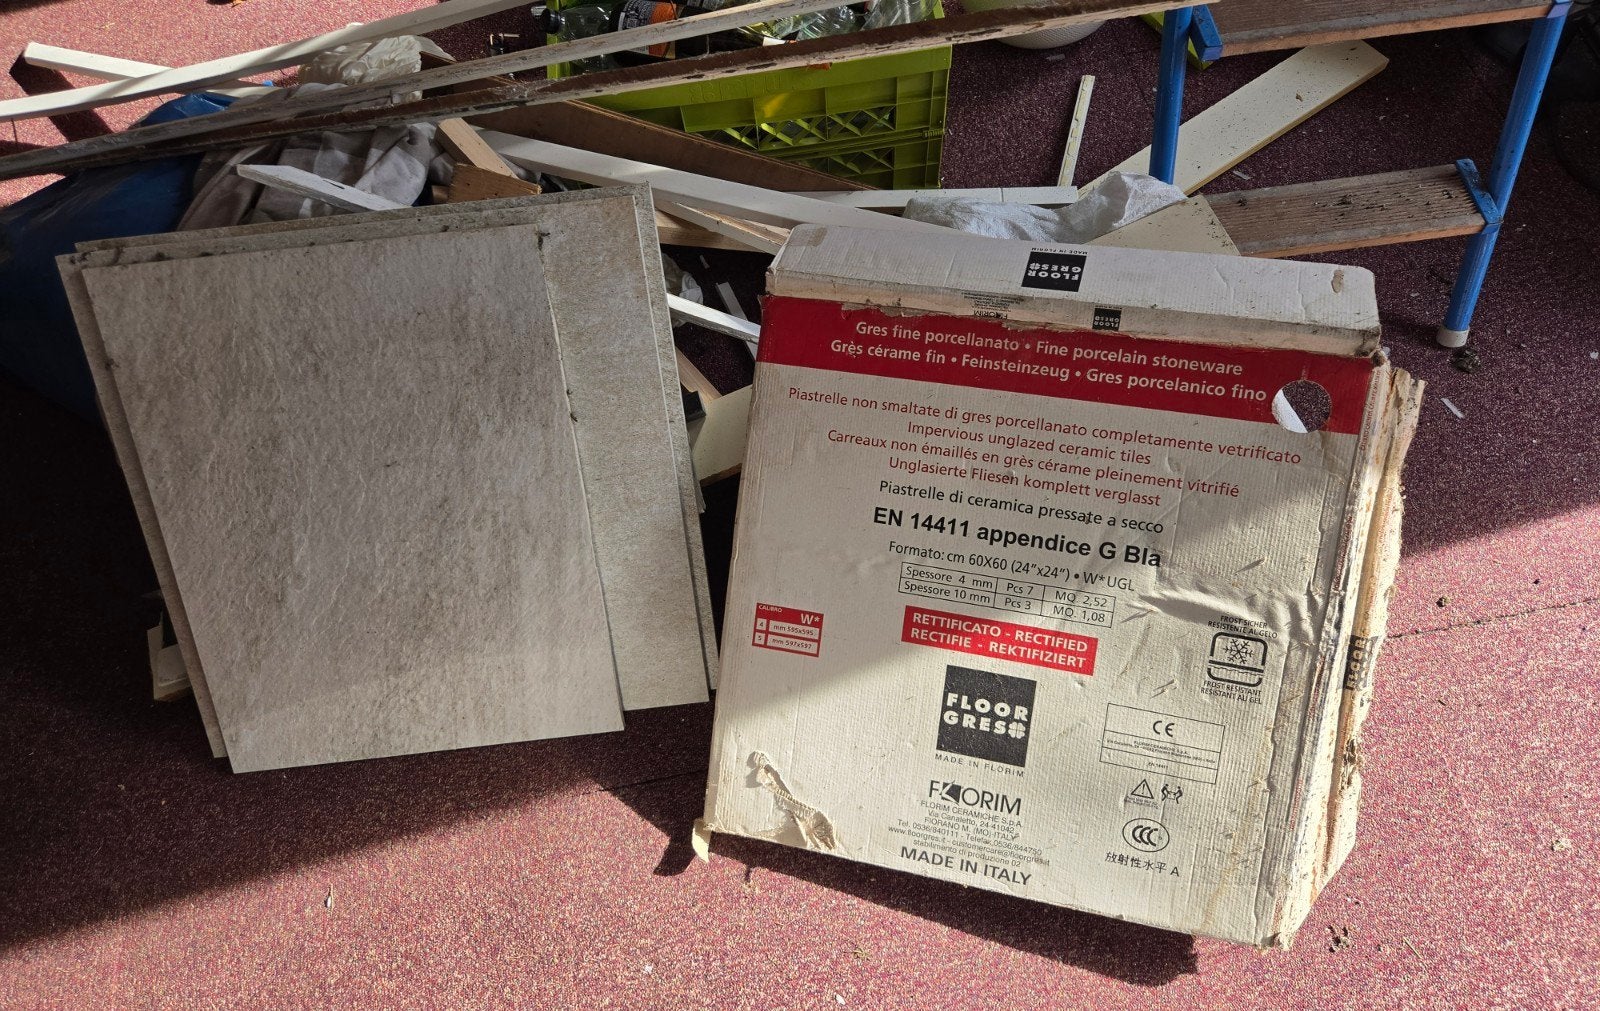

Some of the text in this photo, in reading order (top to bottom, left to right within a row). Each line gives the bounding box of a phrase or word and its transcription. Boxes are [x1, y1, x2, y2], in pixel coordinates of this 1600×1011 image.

[1027, 270, 1079, 281] FLOOR
[1041, 264, 1081, 273] GRES
[856, 321, 1243, 376] Gres fine porcellanato Fine porcelain stoneware
[831, 339, 1267, 401] Grès cérame fin Feinsteinzeug Gres porcelanico fino
[788, 387, 1302, 464] Piastrelle non smaltate di gres porcellanato completamente vetrificato
[908, 421, 1151, 465] Impervious unglazed ceramic tiles
[828, 429, 1240, 498] Carreaux non émaillés en grès cérame pleinement vitrifié
[889, 456, 1161, 507] Unglasierte Fliesen komplett verglasst
[879, 480, 1164, 534] Piastrelle di ceramica pressate a secco
[873, 506, 903, 527] EN
[910, 512, 969, 537] 14411
[976, 526, 1092, 556] appendice
[1099, 541, 1116, 560] G
[889, 541, 945, 561] Formato:
[947, 552, 965, 564] cm
[969, 553, 1008, 570] 60X60
[904, 580, 1105, 623] Spessore 10 mm Pcs 3 MQ. 1,08
[906, 566, 953, 583] Spessore
[958, 575, 966, 585] 4
[972, 578, 993, 589] mm
[1006, 583, 1024, 594] Pcs
[1026, 586, 1034, 596] 7
[1083, 595, 1108, 608] 2,52
[758, 604, 783, 613] CALIBRO
[1220, 615, 1268, 629] FROST SICHER
[912, 612, 1001, 638] RETTIFICATO
[1015, 629, 1088, 653] RECTIFIED
[1208, 620, 1278, 639] RESISTENTE AL GELO
[910, 627, 971, 649] RECTIFIE
[989, 641, 1087, 669] REKTIFIZIERT
[1200, 688, 1262, 705] RESISTANT AU GEL
[1203, 680, 1262, 697] FROST RESISTANT
[946, 692, 1028, 722] FLOOR
[943, 710, 1007, 735] GRES
[1152, 720, 1175, 738] CE
[935, 753, 1025, 777] MADE IN FLORIM
[920, 800, 951, 812] FLORIM
[952, 805, 999, 823] CERAMICHE
[928, 779, 1022, 816] FLORIM
[898, 819, 911, 828] Tel.
[912, 822, 959, 839] 0536/840111
[924, 817, 960, 831] FIORANO
[962, 824, 971, 833] M.
[928, 809, 939, 818] Via
[941, 812, 978, 827] Canaletto,
[888, 826, 946, 843] www.floorgres.it
[900, 846, 1032, 886] MADE IN ITALY
[913, 839, 1021, 868] stabilimento di produzione 02
[1105, 851, 1180, 877] 放射性水平 A
